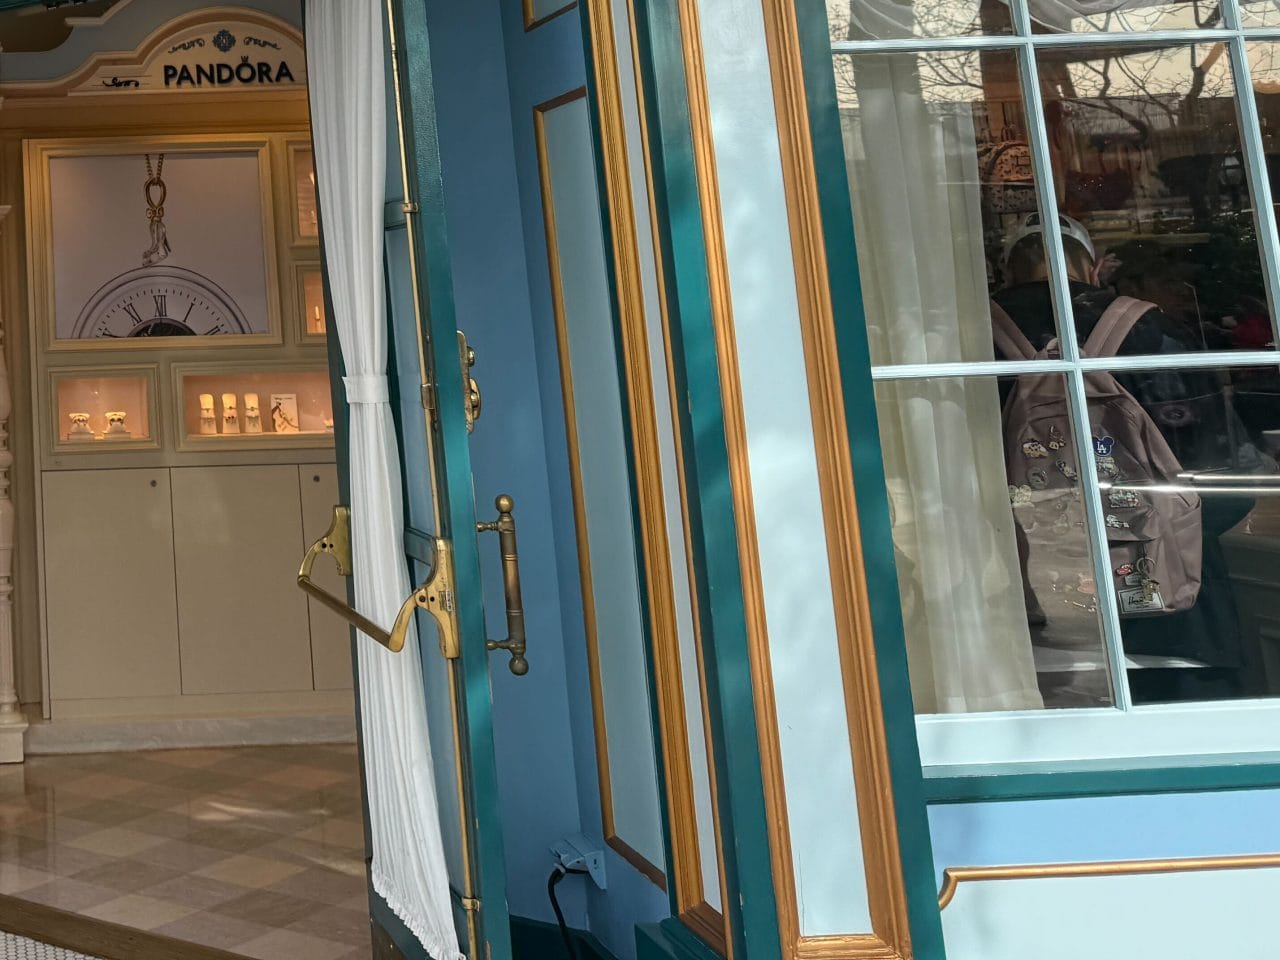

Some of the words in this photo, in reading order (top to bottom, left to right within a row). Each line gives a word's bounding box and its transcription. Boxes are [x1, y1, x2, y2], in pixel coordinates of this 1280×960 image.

[163, 60, 295, 86] PANDORA
[153, 294, 168, 317] XII
[1097, 441, 1107, 454] LA
